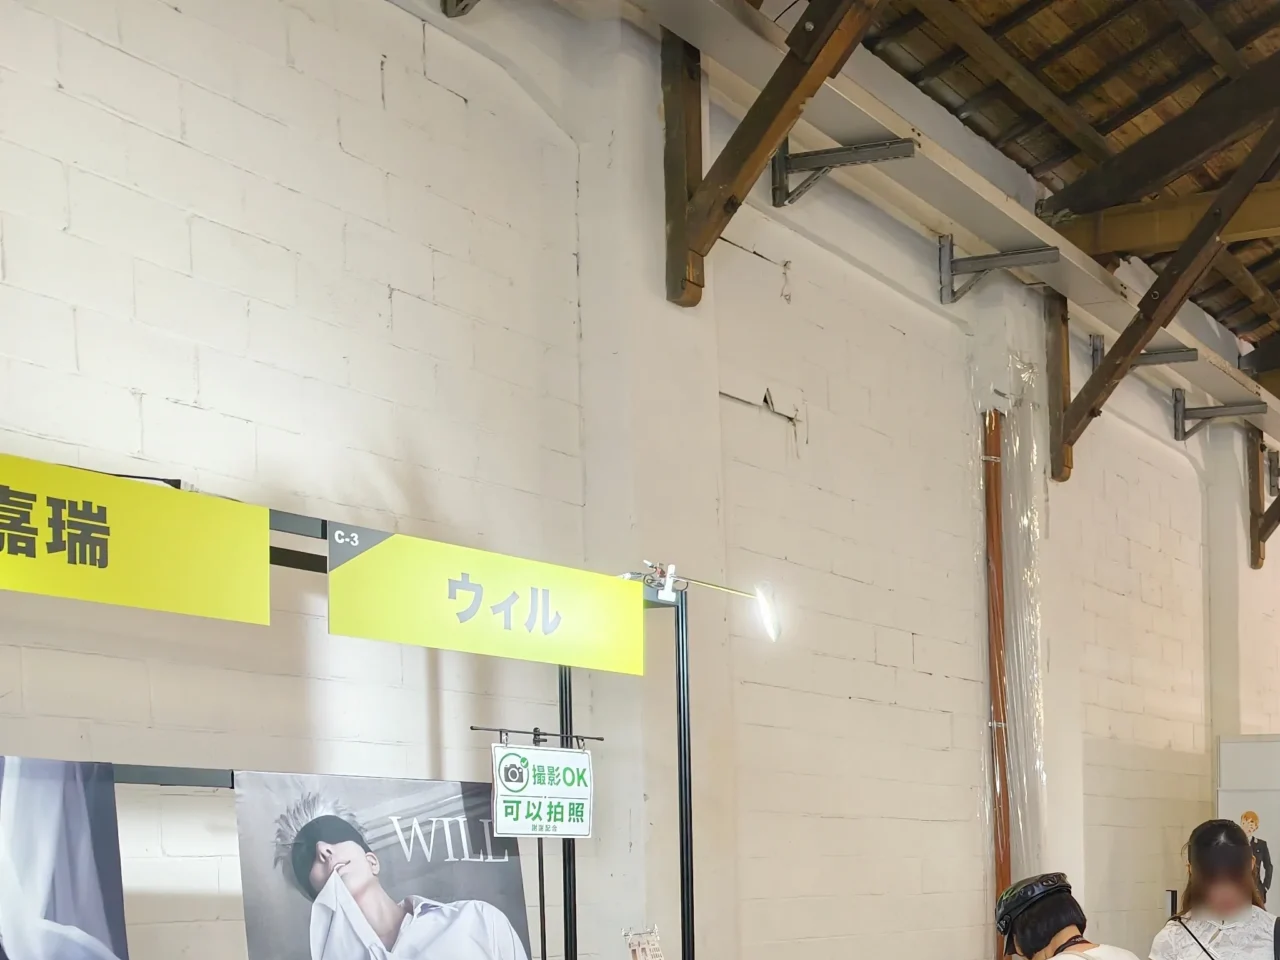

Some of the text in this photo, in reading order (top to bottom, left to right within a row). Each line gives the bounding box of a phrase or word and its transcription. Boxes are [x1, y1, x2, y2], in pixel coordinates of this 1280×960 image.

[334, 530, 359, 546] C-3
[448, 572, 562, 635] ウィル
[532, 764, 588, 787] 撮影OK
[503, 800, 584, 823] 可以拍照
[388, 816, 509, 862] WILL
